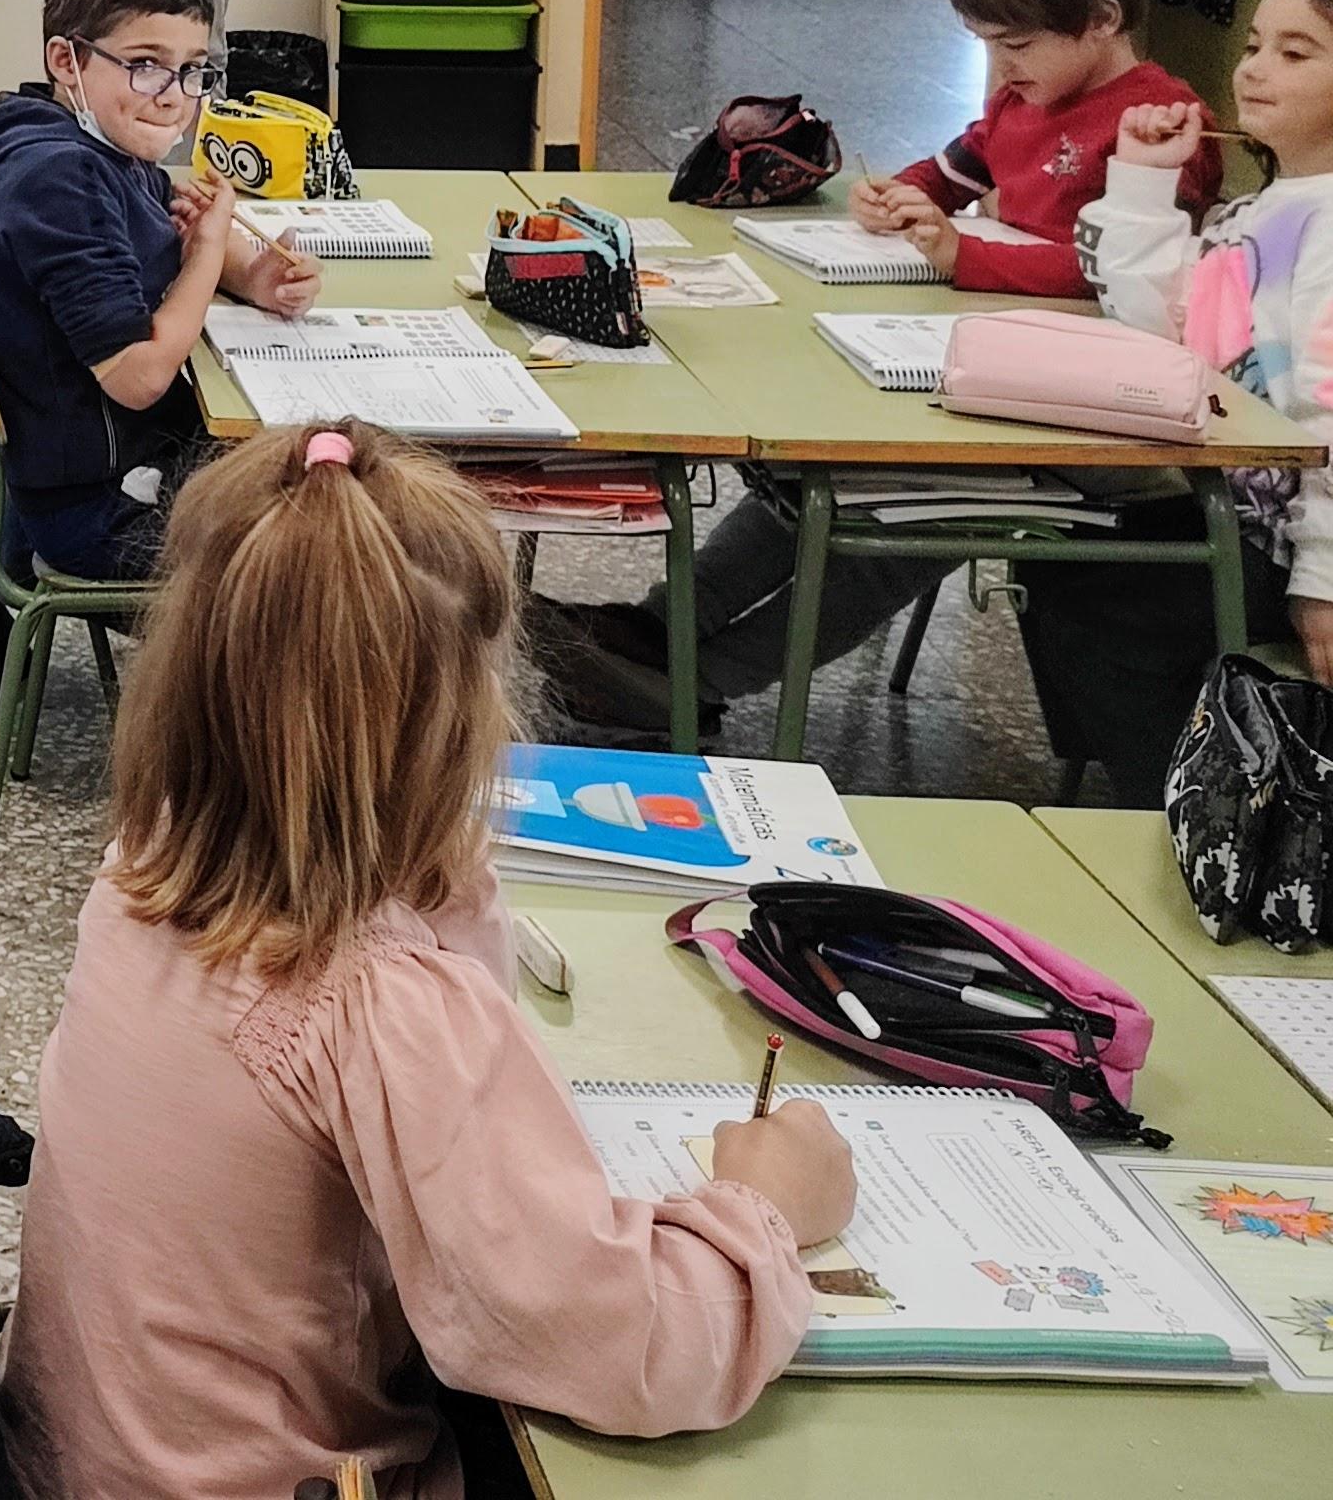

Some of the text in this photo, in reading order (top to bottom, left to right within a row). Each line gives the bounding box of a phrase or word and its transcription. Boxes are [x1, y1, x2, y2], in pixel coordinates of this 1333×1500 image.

[1123, 385, 1159, 396] SPECIAL
[724, 766, 777, 843] Matemáticas
[1006, 1119, 1048, 1153] TAREFA
[1047, 1166, 1090, 1202] Escribir
